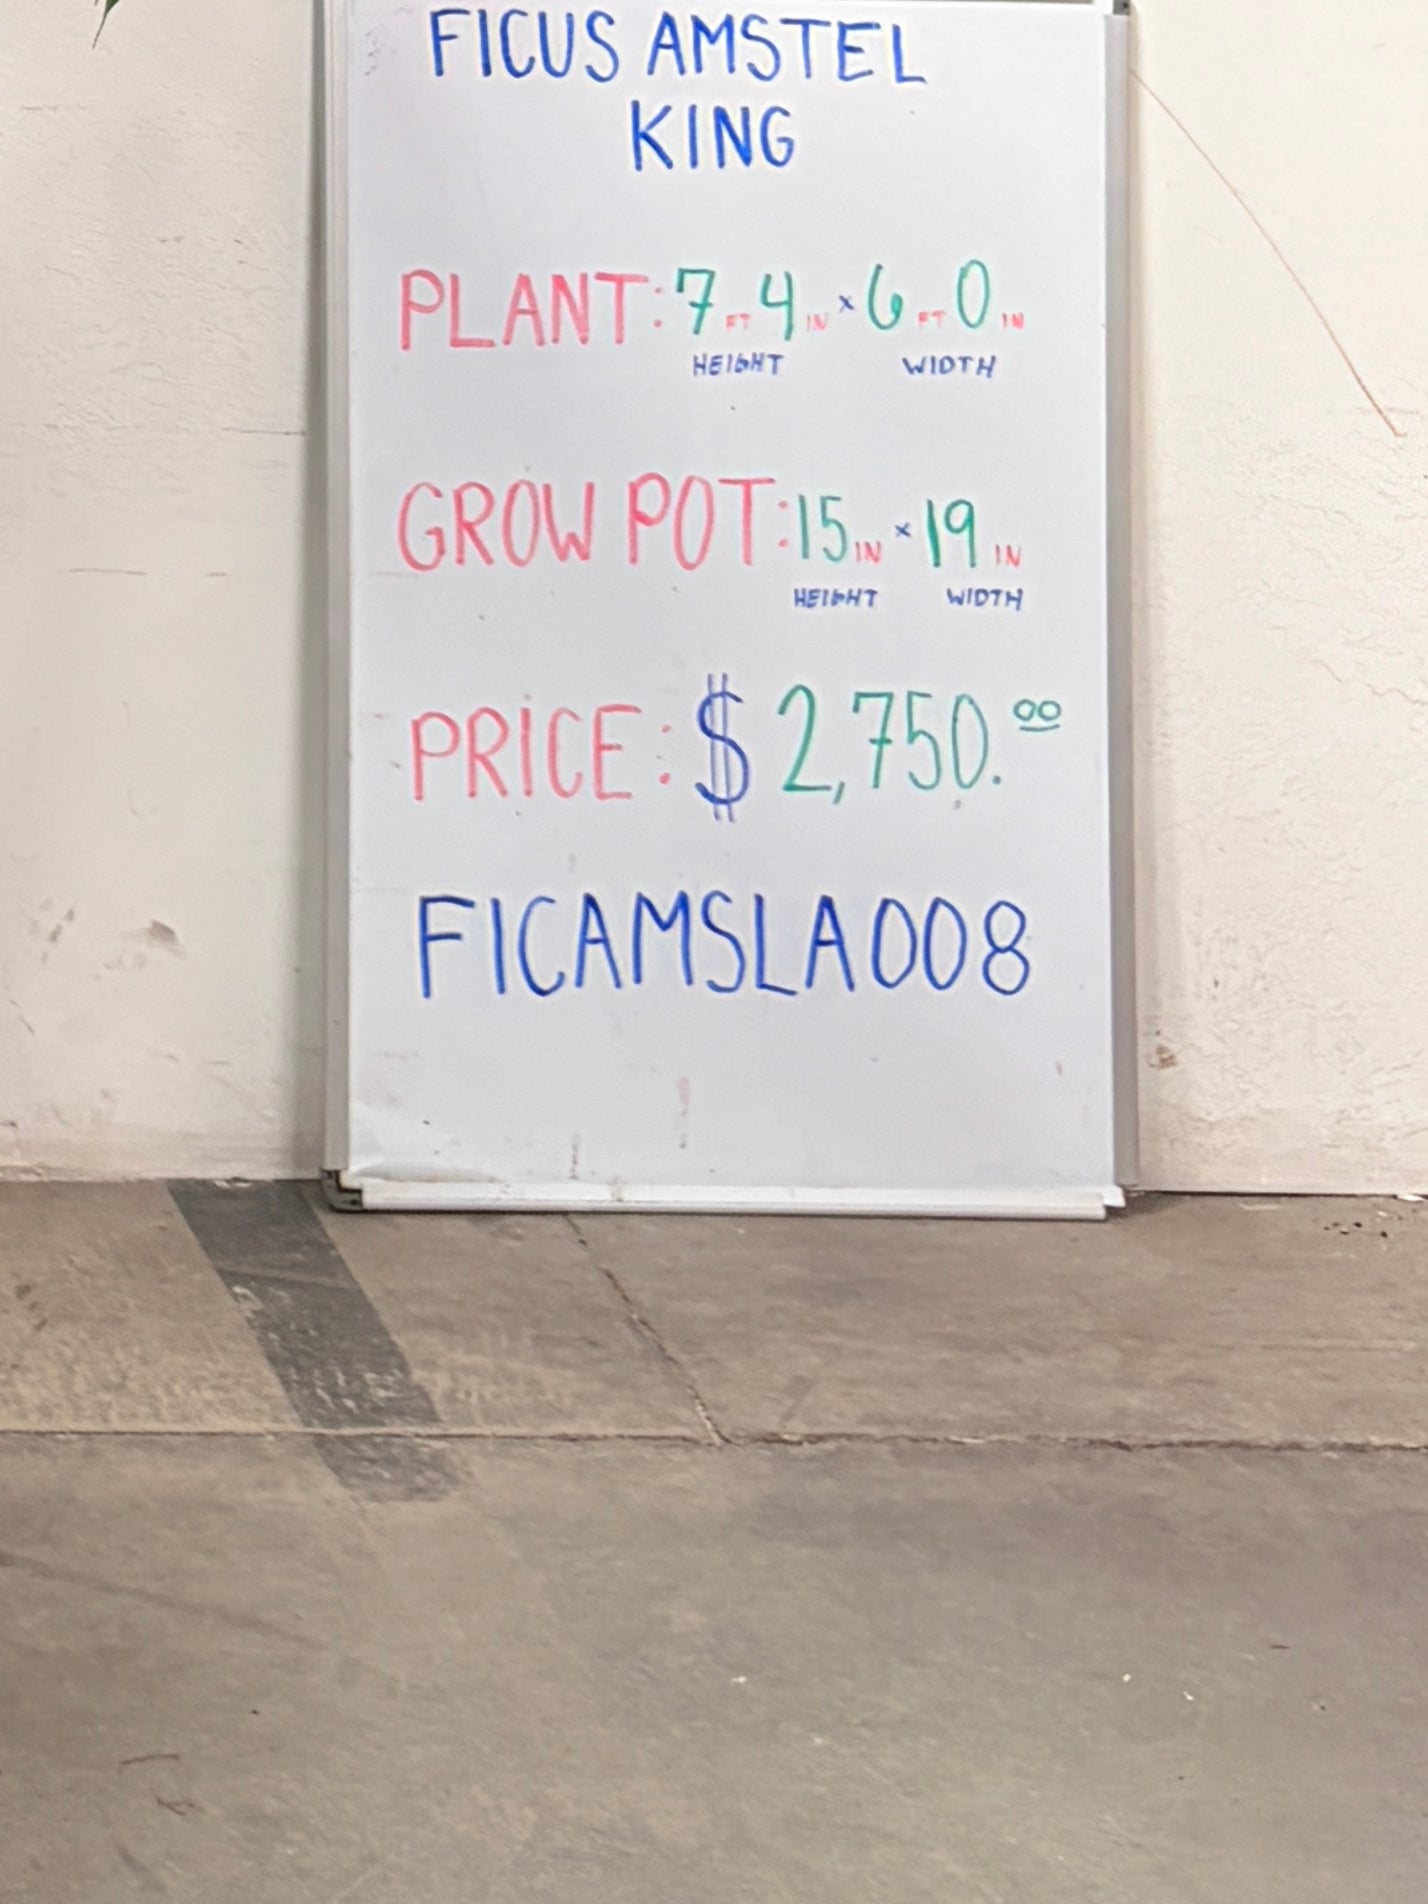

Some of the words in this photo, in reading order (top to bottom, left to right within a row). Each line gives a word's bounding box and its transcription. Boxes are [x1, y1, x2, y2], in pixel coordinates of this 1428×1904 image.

[429, 8, 620, 84] FICUS
[646, 11, 926, 85] AMSTEL
[630, 99, 795, 172] KING
[400, 268, 664, 352] PLANT:
[693, 353, 784, 377] HEIGHT
[902, 354, 997, 378] WIDTH
[396, 480, 596, 571] GROW
[626, 472, 789, 571] POT:
[793, 588, 879, 609] HEIGHT
[945, 588, 1024, 612] WIDTH
[416, 890, 1031, 999] FICAMSLA008
